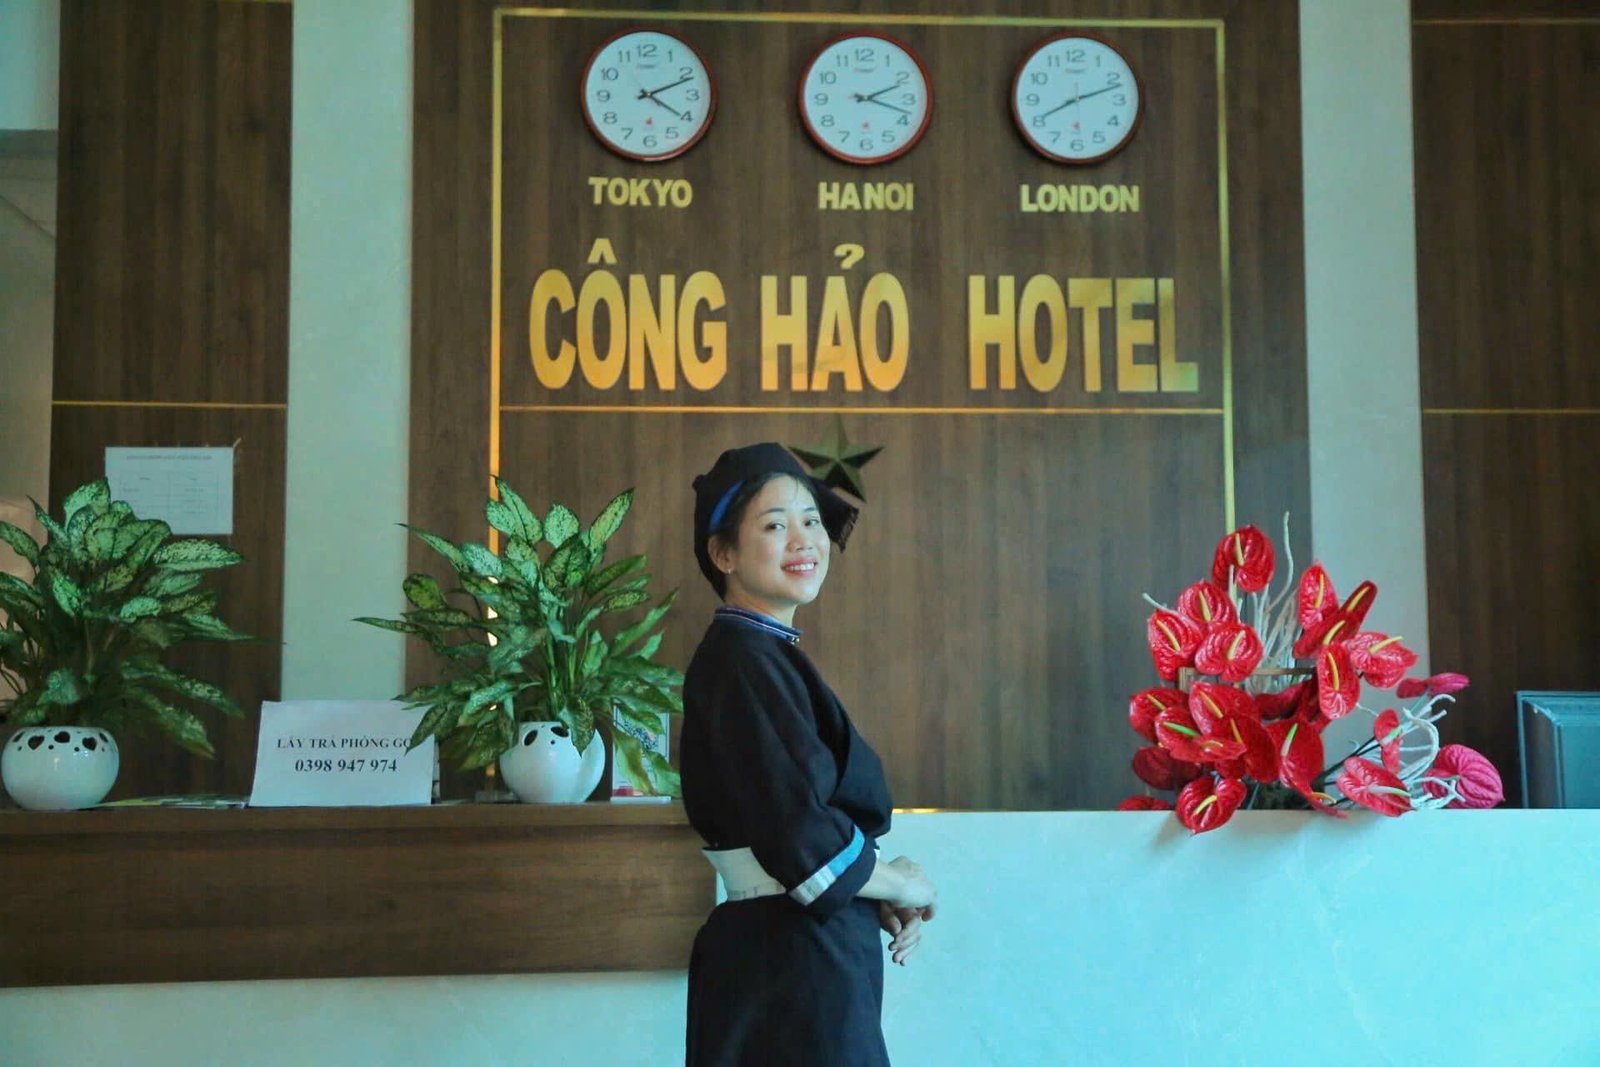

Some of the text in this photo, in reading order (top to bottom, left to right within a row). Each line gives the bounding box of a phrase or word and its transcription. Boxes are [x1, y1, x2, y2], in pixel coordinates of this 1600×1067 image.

[618, 50, 631, 63] 11
[637, 44, 657, 57] 12
[668, 50, 673, 62] 1
[855, 48, 875, 62] 12
[1066, 49, 1086, 63] 12
[836, 54, 849, 67] 11
[885, 54, 890, 67] 1
[1047, 55, 1060, 68] 11
[1095, 55, 1101, 68] 1
[601, 67, 619, 81] 10
[679, 67, 694, 80] 2
[820, 71, 837, 85] 10
[895, 71, 910, 85] 2
[1031, 72, 1048, 86] 10
[1107, 72, 1121, 85] 2
[596, 90, 610, 102] 9
[686, 89, 700, 101] 3
[814, 93, 829, 106] 9
[901, 93, 916, 106] 3
[1026, 93, 1040, 106] 9
[1112, 93, 1127, 106] 3
[603, 112, 618, 124] 8
[680, 110, 693, 122] 4
[820, 114, 835, 128] 8
[896, 115, 910, 126] 4
[1032, 115, 1046, 128] 8
[1107, 115, 1119, 127] 4
[621, 127, 633, 140] 7
[666, 127, 679, 139] 5
[838, 130, 850, 143] 7
[882, 130, 895, 143] 5
[1048, 131, 1061, 144] 7
[1092, 131, 1106, 143] 5
[643, 135, 657, 148] 6
[860, 138, 874, 151] 6
[1070, 139, 1084, 152] 6
[588, 176, 693, 208] TOKYO
[818, 181, 914, 210] HANOI
[1020, 184, 1140, 212] LONDON
[529, 238, 1199, 392] CÔNG HẢO HOTEL
[341, 736, 389, 749] PHÒNG
[295, 759, 397, 772] 0398 947 974
